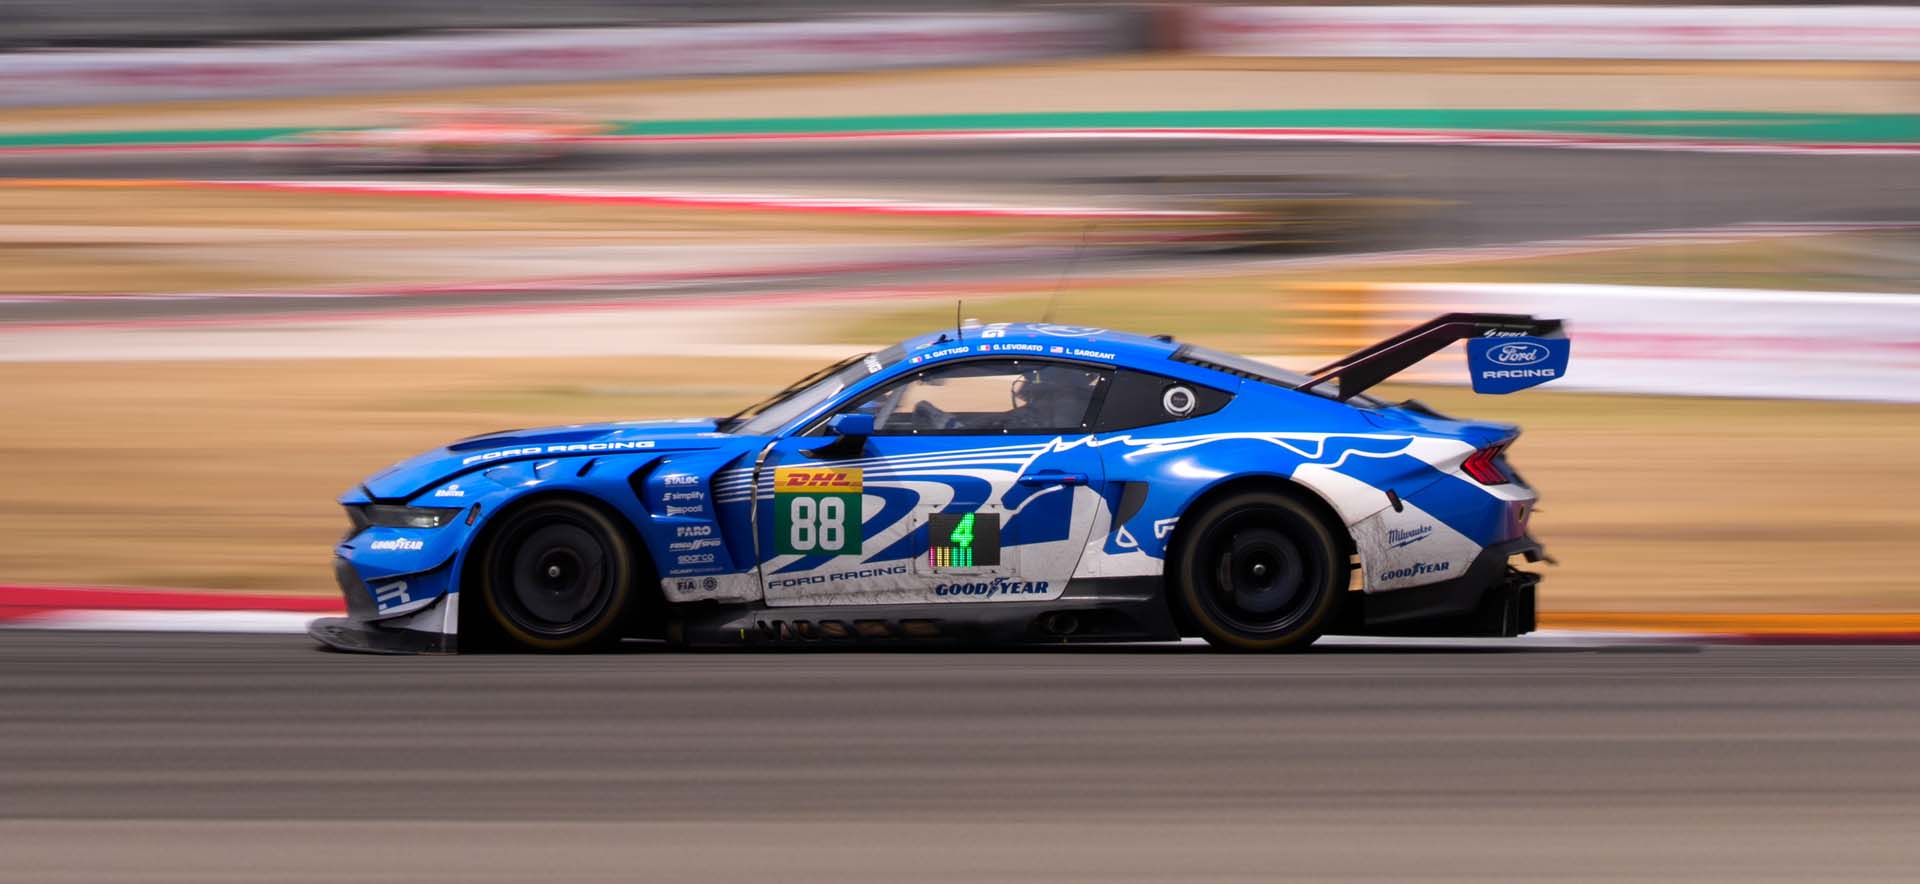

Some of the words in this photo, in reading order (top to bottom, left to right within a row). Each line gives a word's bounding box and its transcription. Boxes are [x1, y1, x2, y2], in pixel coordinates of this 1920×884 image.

[932, 346, 969, 358] GATTUSO
[1002, 344, 1043, 352] LEVORATO
[1074, 349, 1116, 360] SARGEANT
[1498, 345, 1538, 362] Ford
[1482, 368, 1555, 379] RACING
[463, 447, 541, 464] FORD
[548, 441, 656, 453] RACING
[786, 473, 850, 486] DHL
[677, 525, 711, 537] FARO
[790, 496, 845, 551] 88
[950, 512, 976, 548] 4
[1388, 524, 1432, 545] Milwaukee
[371, 537, 424, 551] GOODYEAR
[768, 575, 825, 589] FORD
[830, 566, 907, 581] RACING
[1381, 562, 1450, 581] GOODYEAR
[678, 582, 695, 591] FIA
[935, 577, 1049, 598] GOODYEAR
